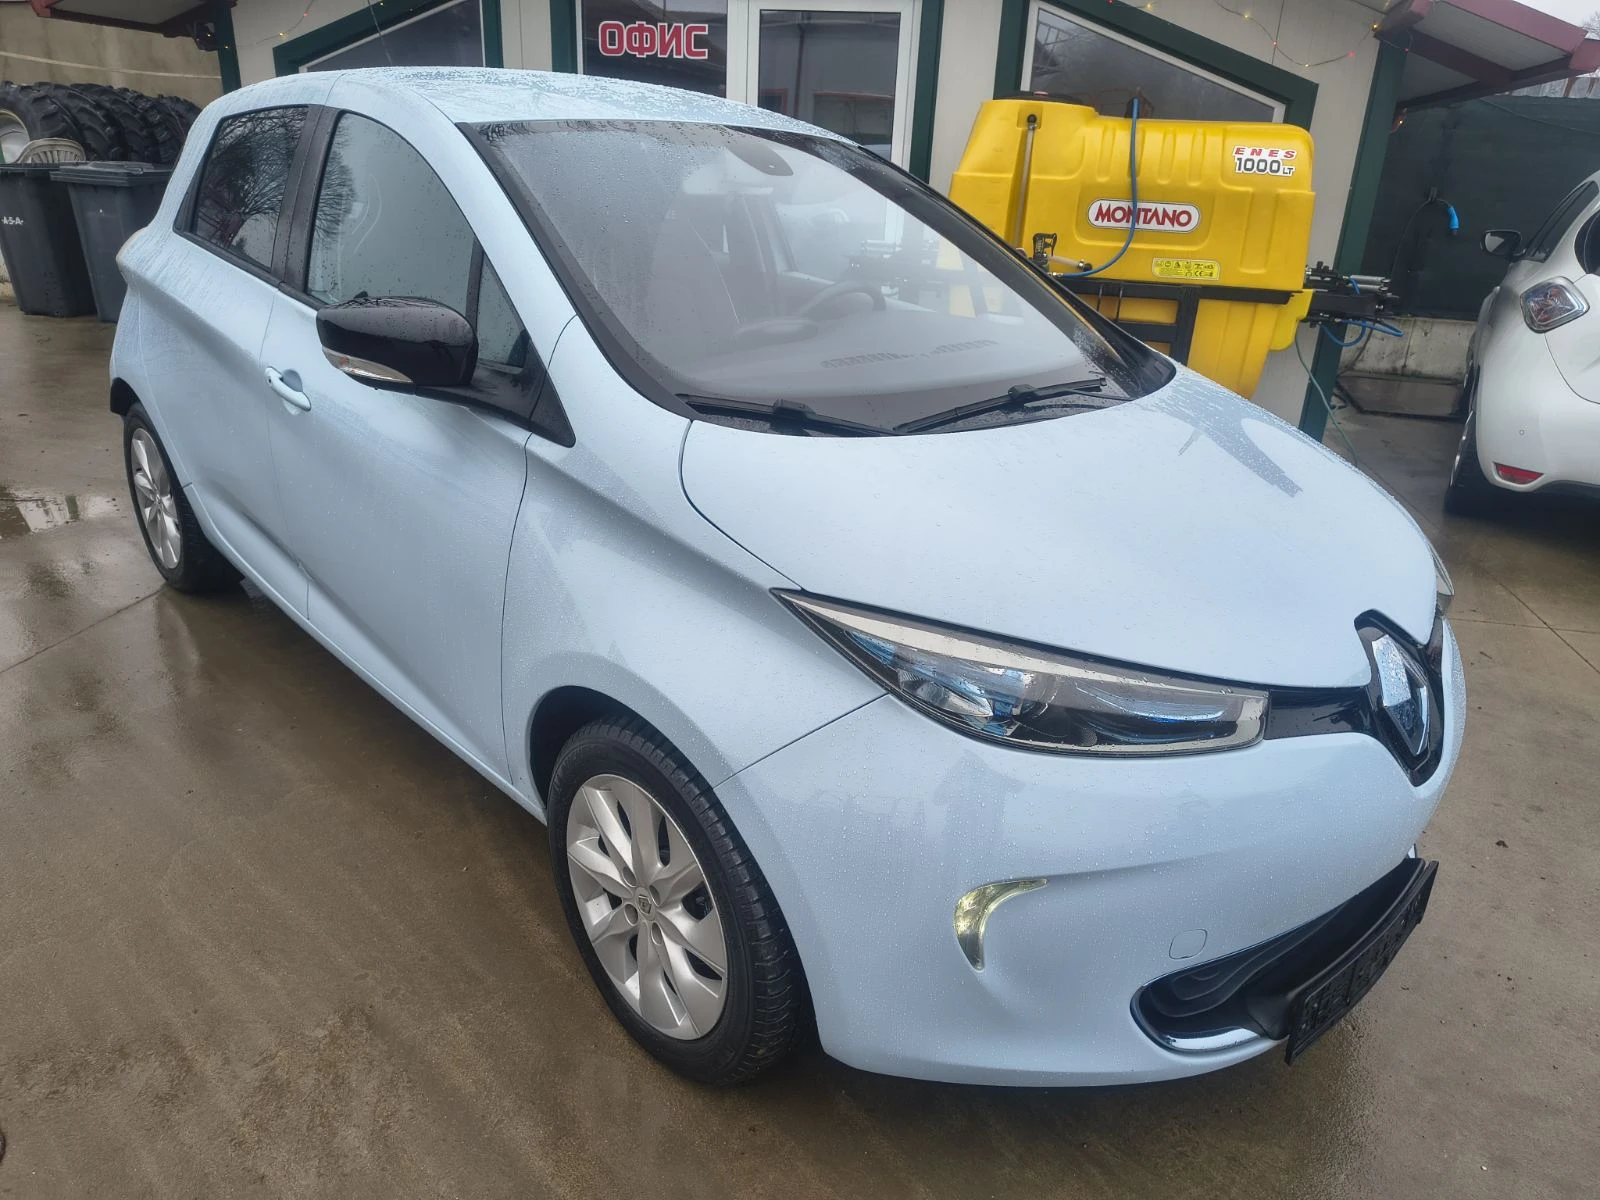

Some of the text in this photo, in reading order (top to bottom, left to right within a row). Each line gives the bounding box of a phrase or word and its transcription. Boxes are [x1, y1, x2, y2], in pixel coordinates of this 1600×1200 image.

[599, 21, 708, 59] ОФИС
[1235, 147, 1295, 158] ENES
[1237, 158, 1280, 173] 1000
[1095, 203, 1192, 228] MONTANO
